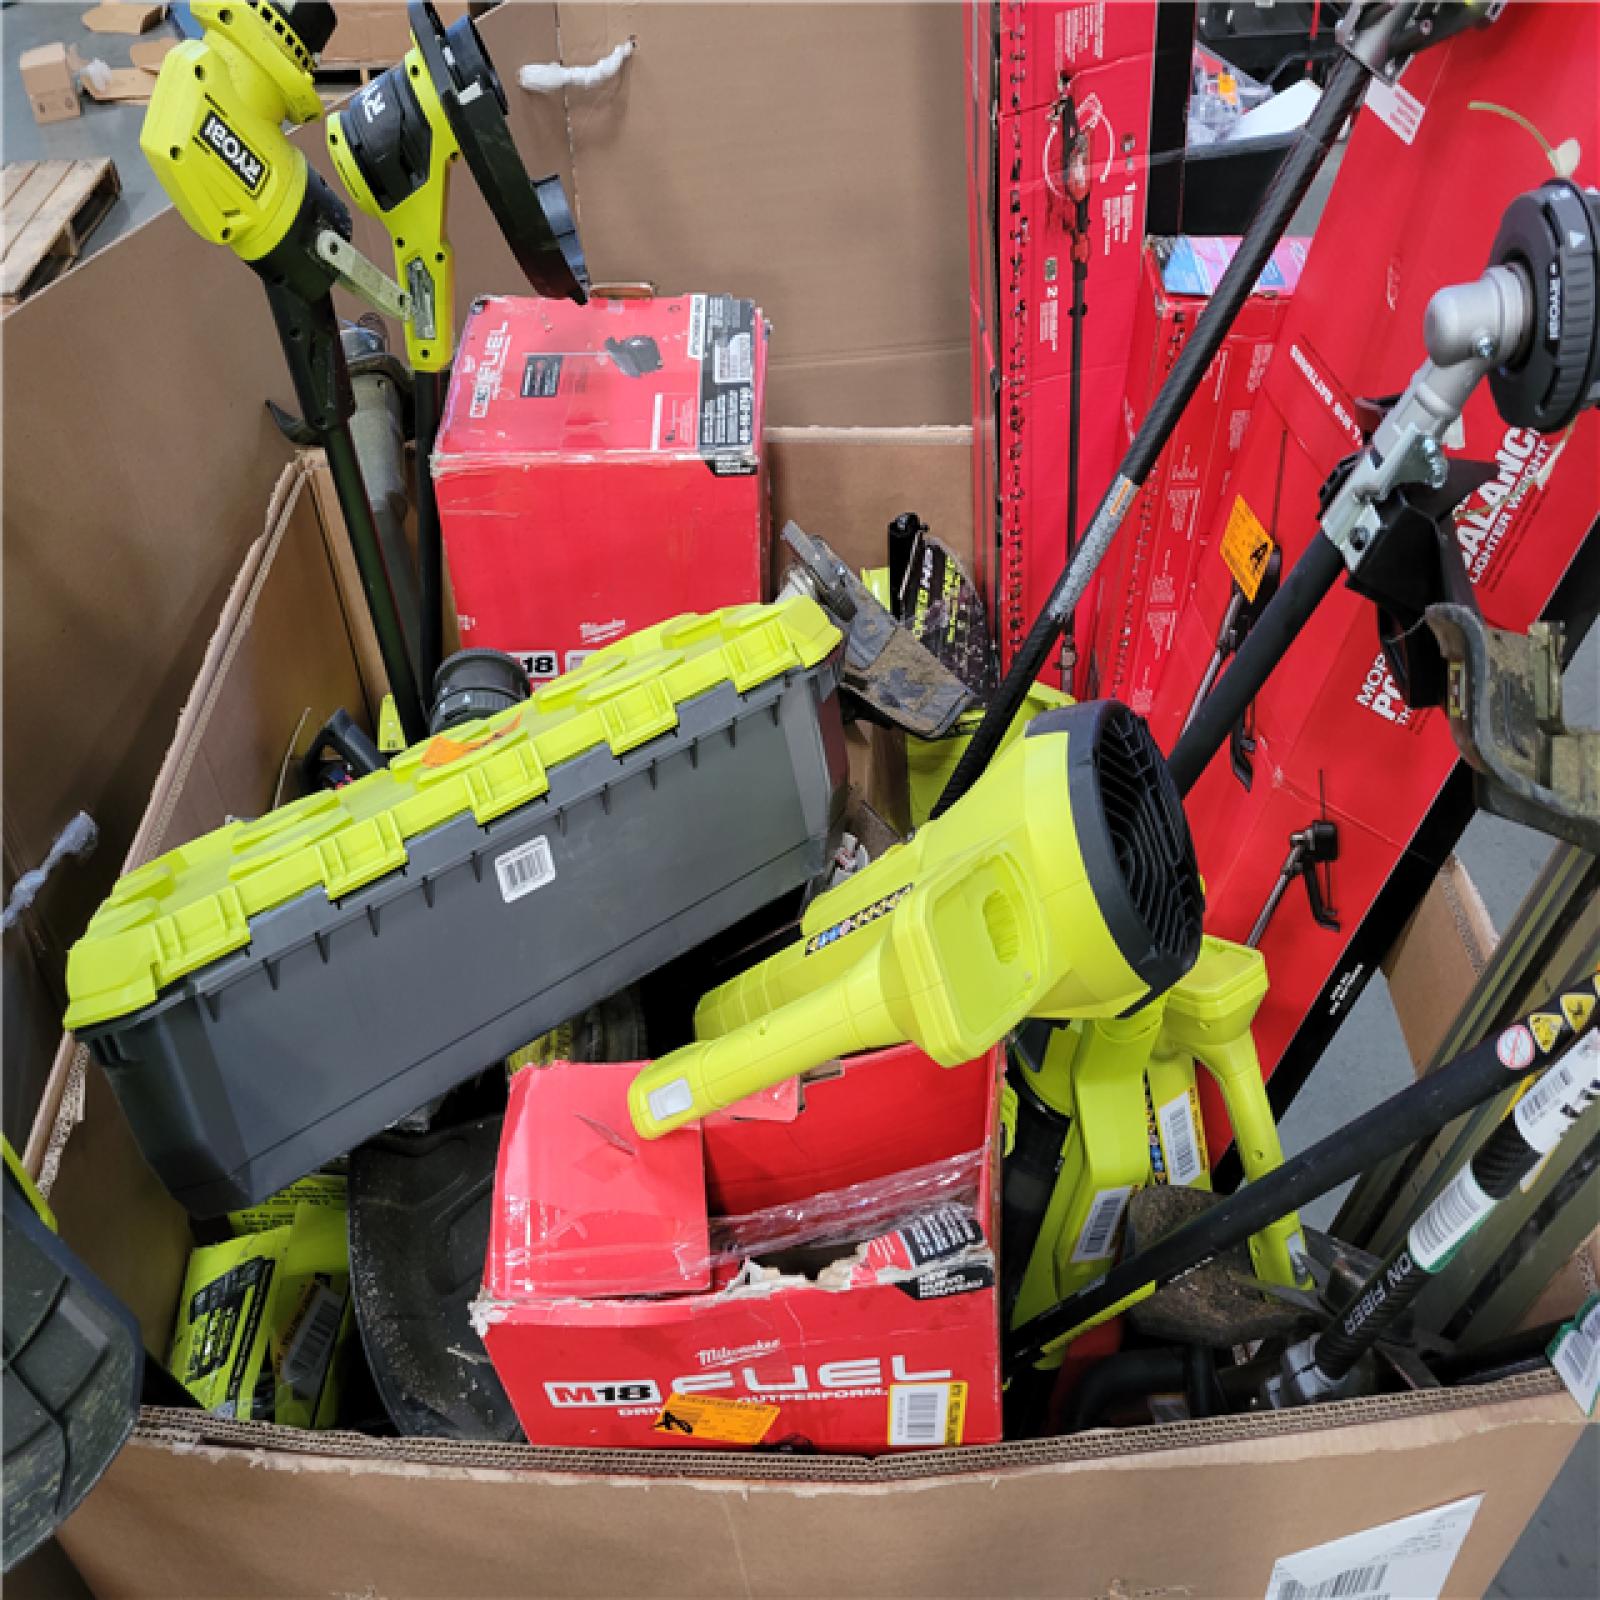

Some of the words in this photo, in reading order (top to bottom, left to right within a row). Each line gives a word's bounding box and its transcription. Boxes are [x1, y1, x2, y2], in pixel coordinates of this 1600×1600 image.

[204, 115, 263, 186] RYOBI
[1548, 277, 1561, 339] RYOBI
[1457, 427, 1541, 571] ALANC
[1470, 511, 1513, 584] LIGHTER
[1386, 1252, 1413, 1287] ON
[1344, 1281, 1388, 1335] FIBER
[554, 1383, 652, 1404] M18
[672, 1353, 952, 1395] FUEL
[699, 1338, 781, 1366] Milwaukee
